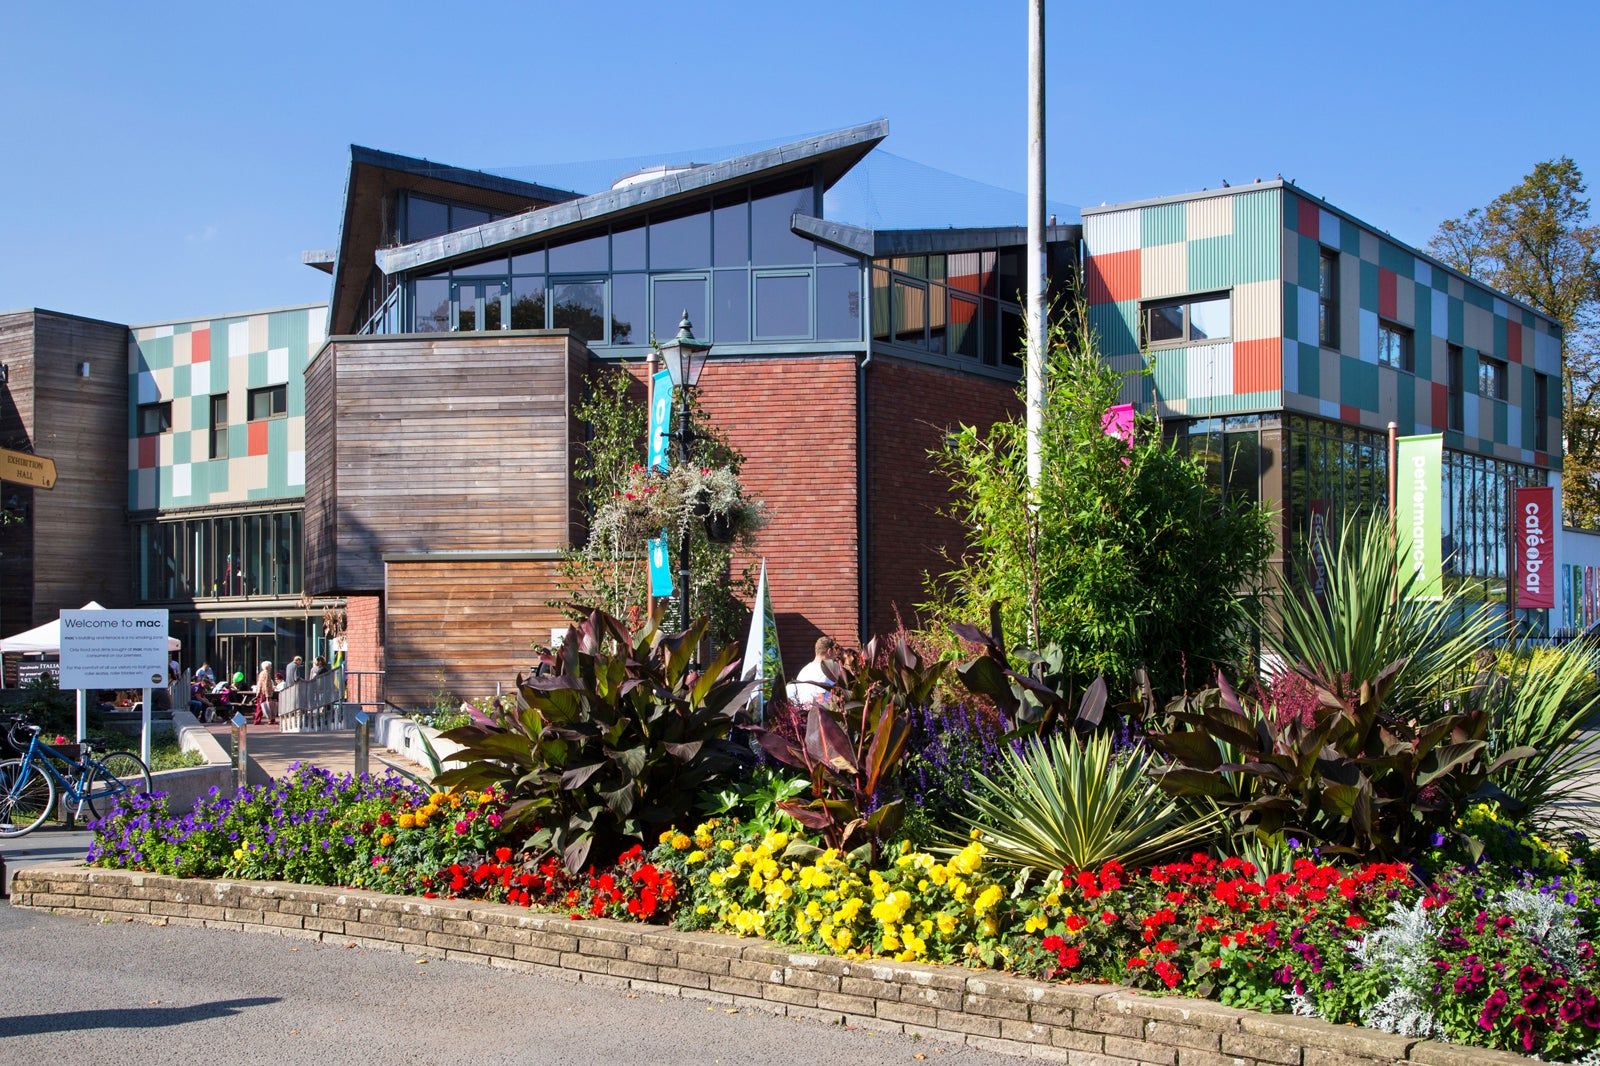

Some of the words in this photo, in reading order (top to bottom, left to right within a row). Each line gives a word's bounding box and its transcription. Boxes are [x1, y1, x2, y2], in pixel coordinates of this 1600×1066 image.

[7, 455, 44, 470] EXHIBITION
[16, 470, 33, 480] HALL
[65, 618, 118, 628] Welcome
[121, 618, 133, 628] to
